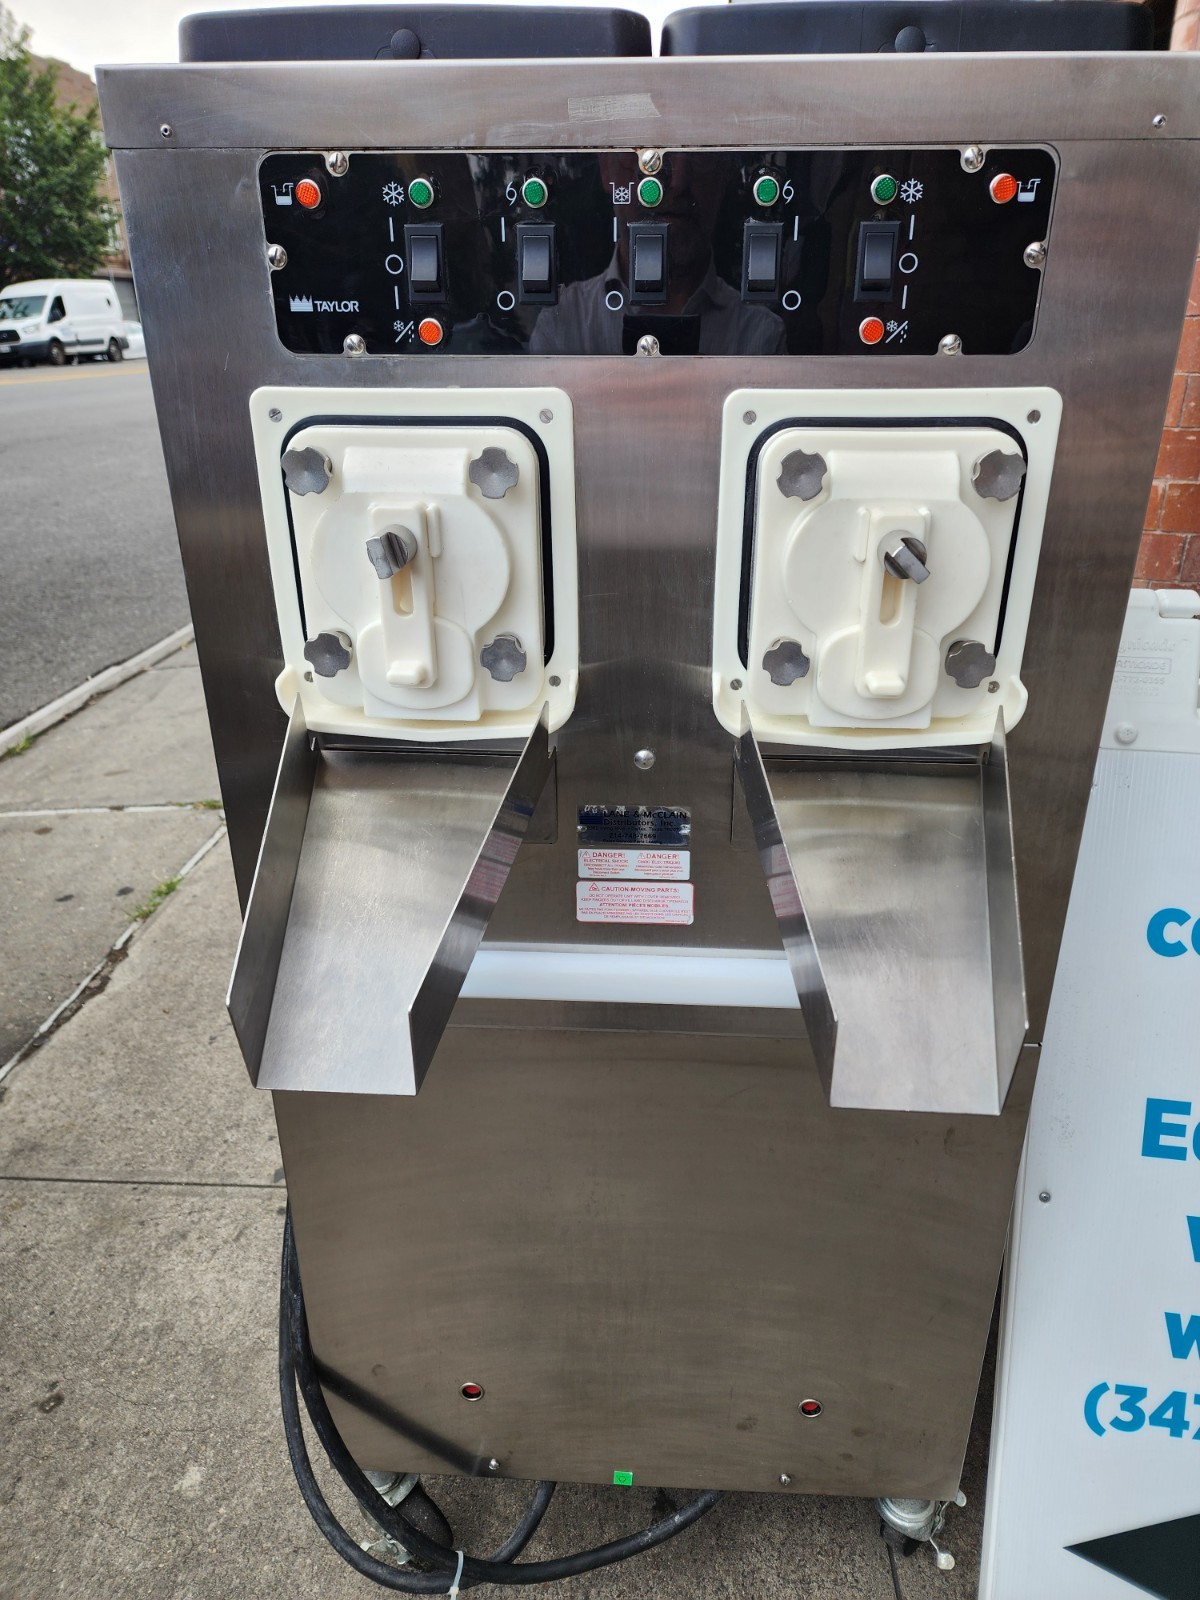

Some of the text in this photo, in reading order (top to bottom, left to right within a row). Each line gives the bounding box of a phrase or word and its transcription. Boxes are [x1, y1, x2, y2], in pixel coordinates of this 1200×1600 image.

[314, 300, 360, 312] TAYLOR
[603, 810, 630, 818] LANE
[643, 811, 687, 819] McCLAIN
[1141, 1097, 1200, 1161] E
